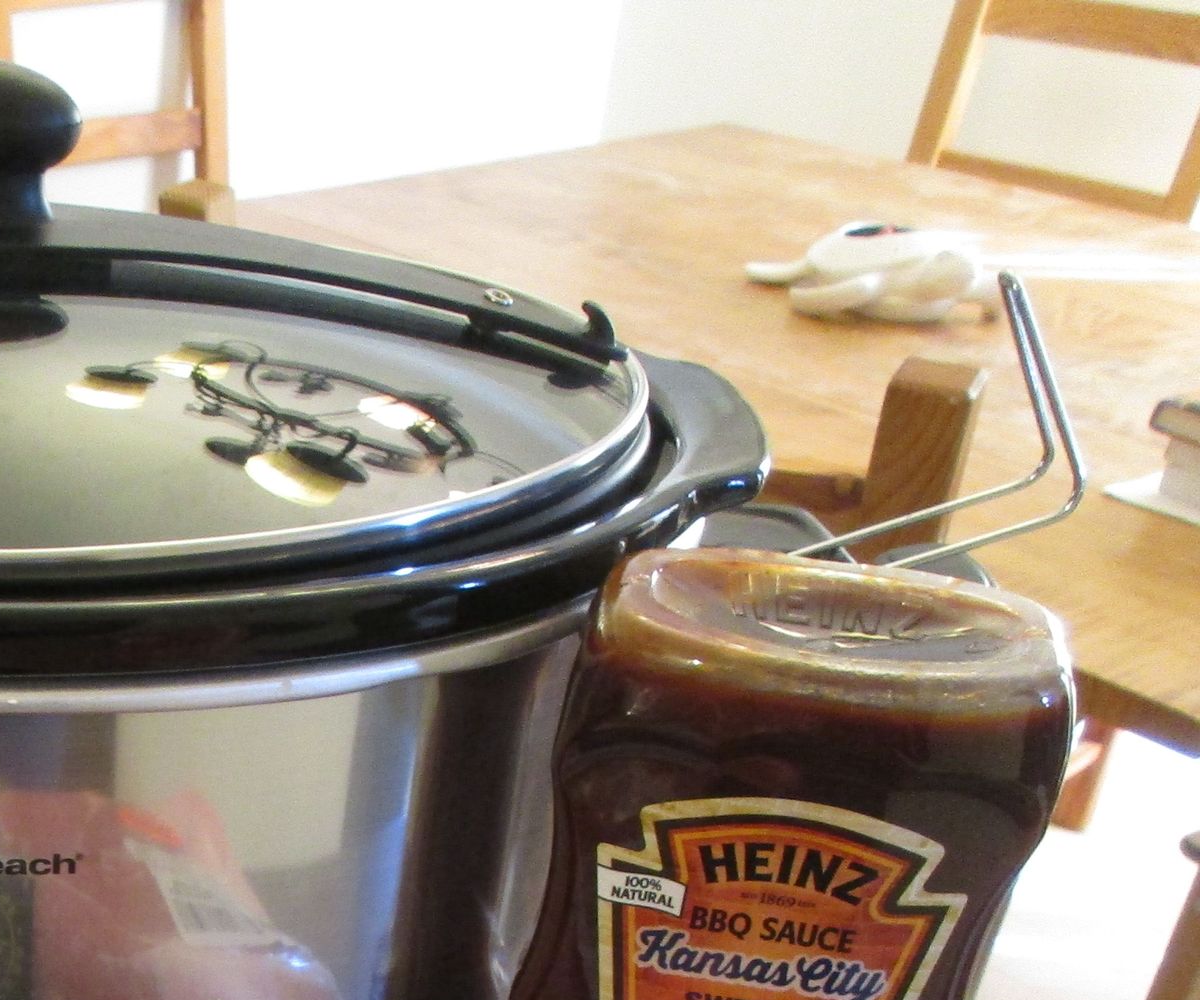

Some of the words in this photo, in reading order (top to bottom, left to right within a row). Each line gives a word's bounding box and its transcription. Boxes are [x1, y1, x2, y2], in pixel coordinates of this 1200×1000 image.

[625, 875, 662, 891] 100%
[699, 841, 879, 907] HEINZ
[611, 886, 675, 909] NATURAL
[760, 892, 796, 907] 1869
[689, 905, 752, 939] BBQ
[760, 917, 858, 953] SAUCE
[638, 928, 797, 986] Kansas
